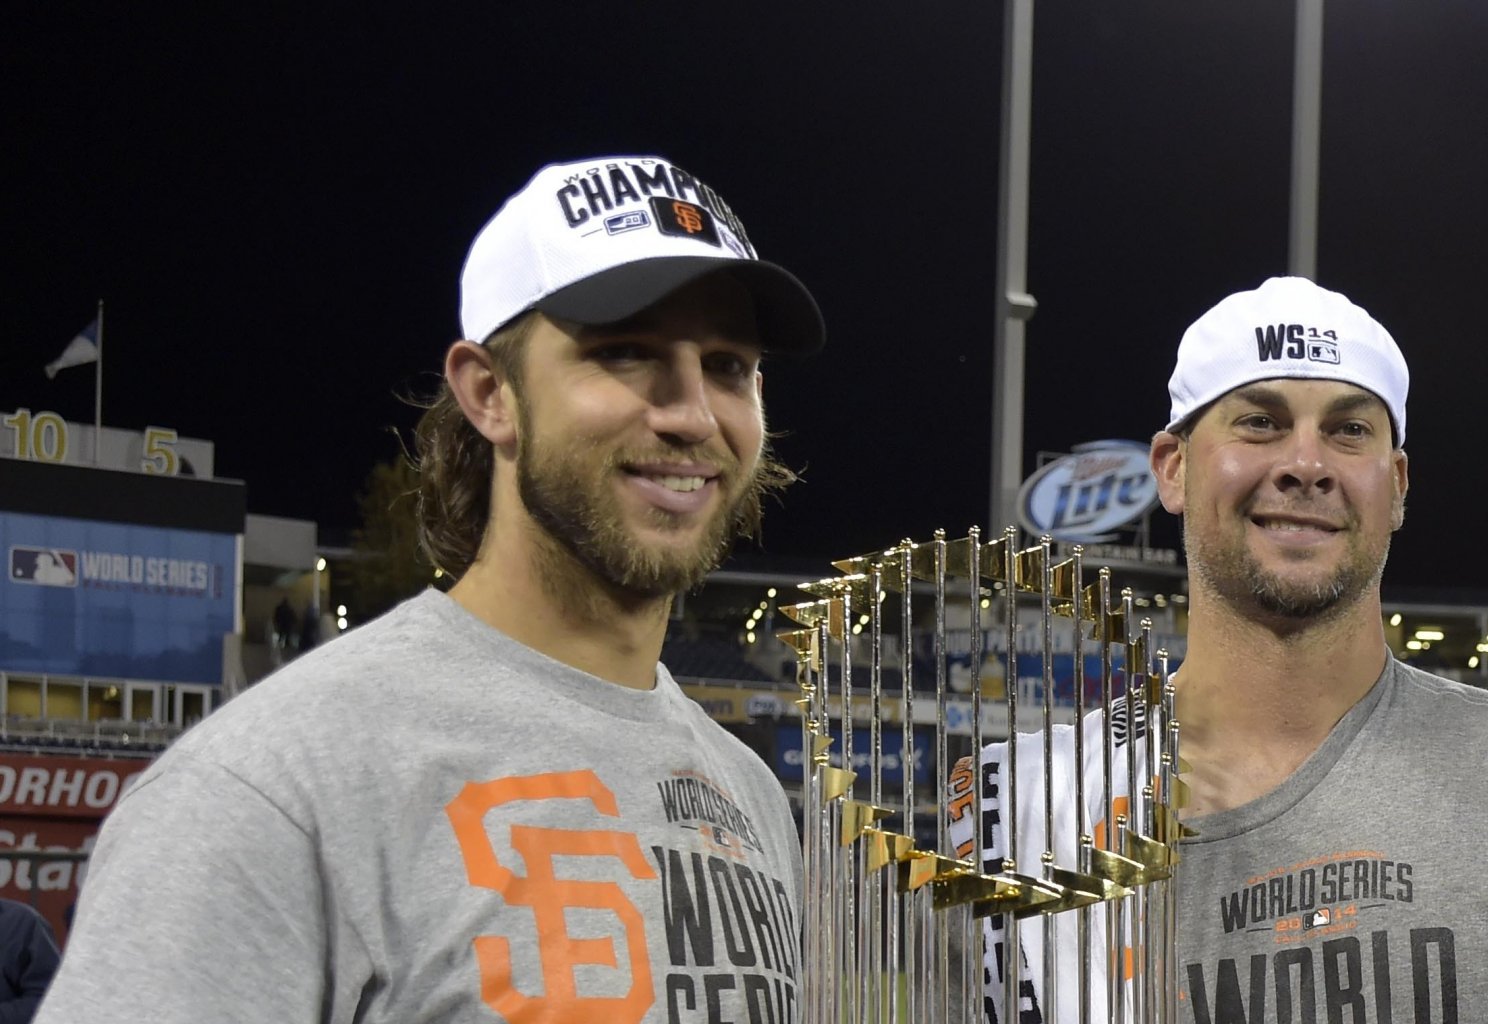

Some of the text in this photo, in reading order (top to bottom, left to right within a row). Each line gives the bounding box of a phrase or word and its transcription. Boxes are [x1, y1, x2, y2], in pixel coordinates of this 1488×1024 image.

[557, 163, 757, 259] CHAMPIO
[1255, 324, 1338, 362] WS 14
[4, 408, 181, 476] 10 5
[83, 551, 142, 583] WORLD
[146, 556, 207, 590] SERIES
[657, 778, 716, 823] WORLD
[651, 846, 798, 986] WORLD
[1220, 869, 1316, 934] WORLD
[1320, 859, 1413, 904] SERIES
